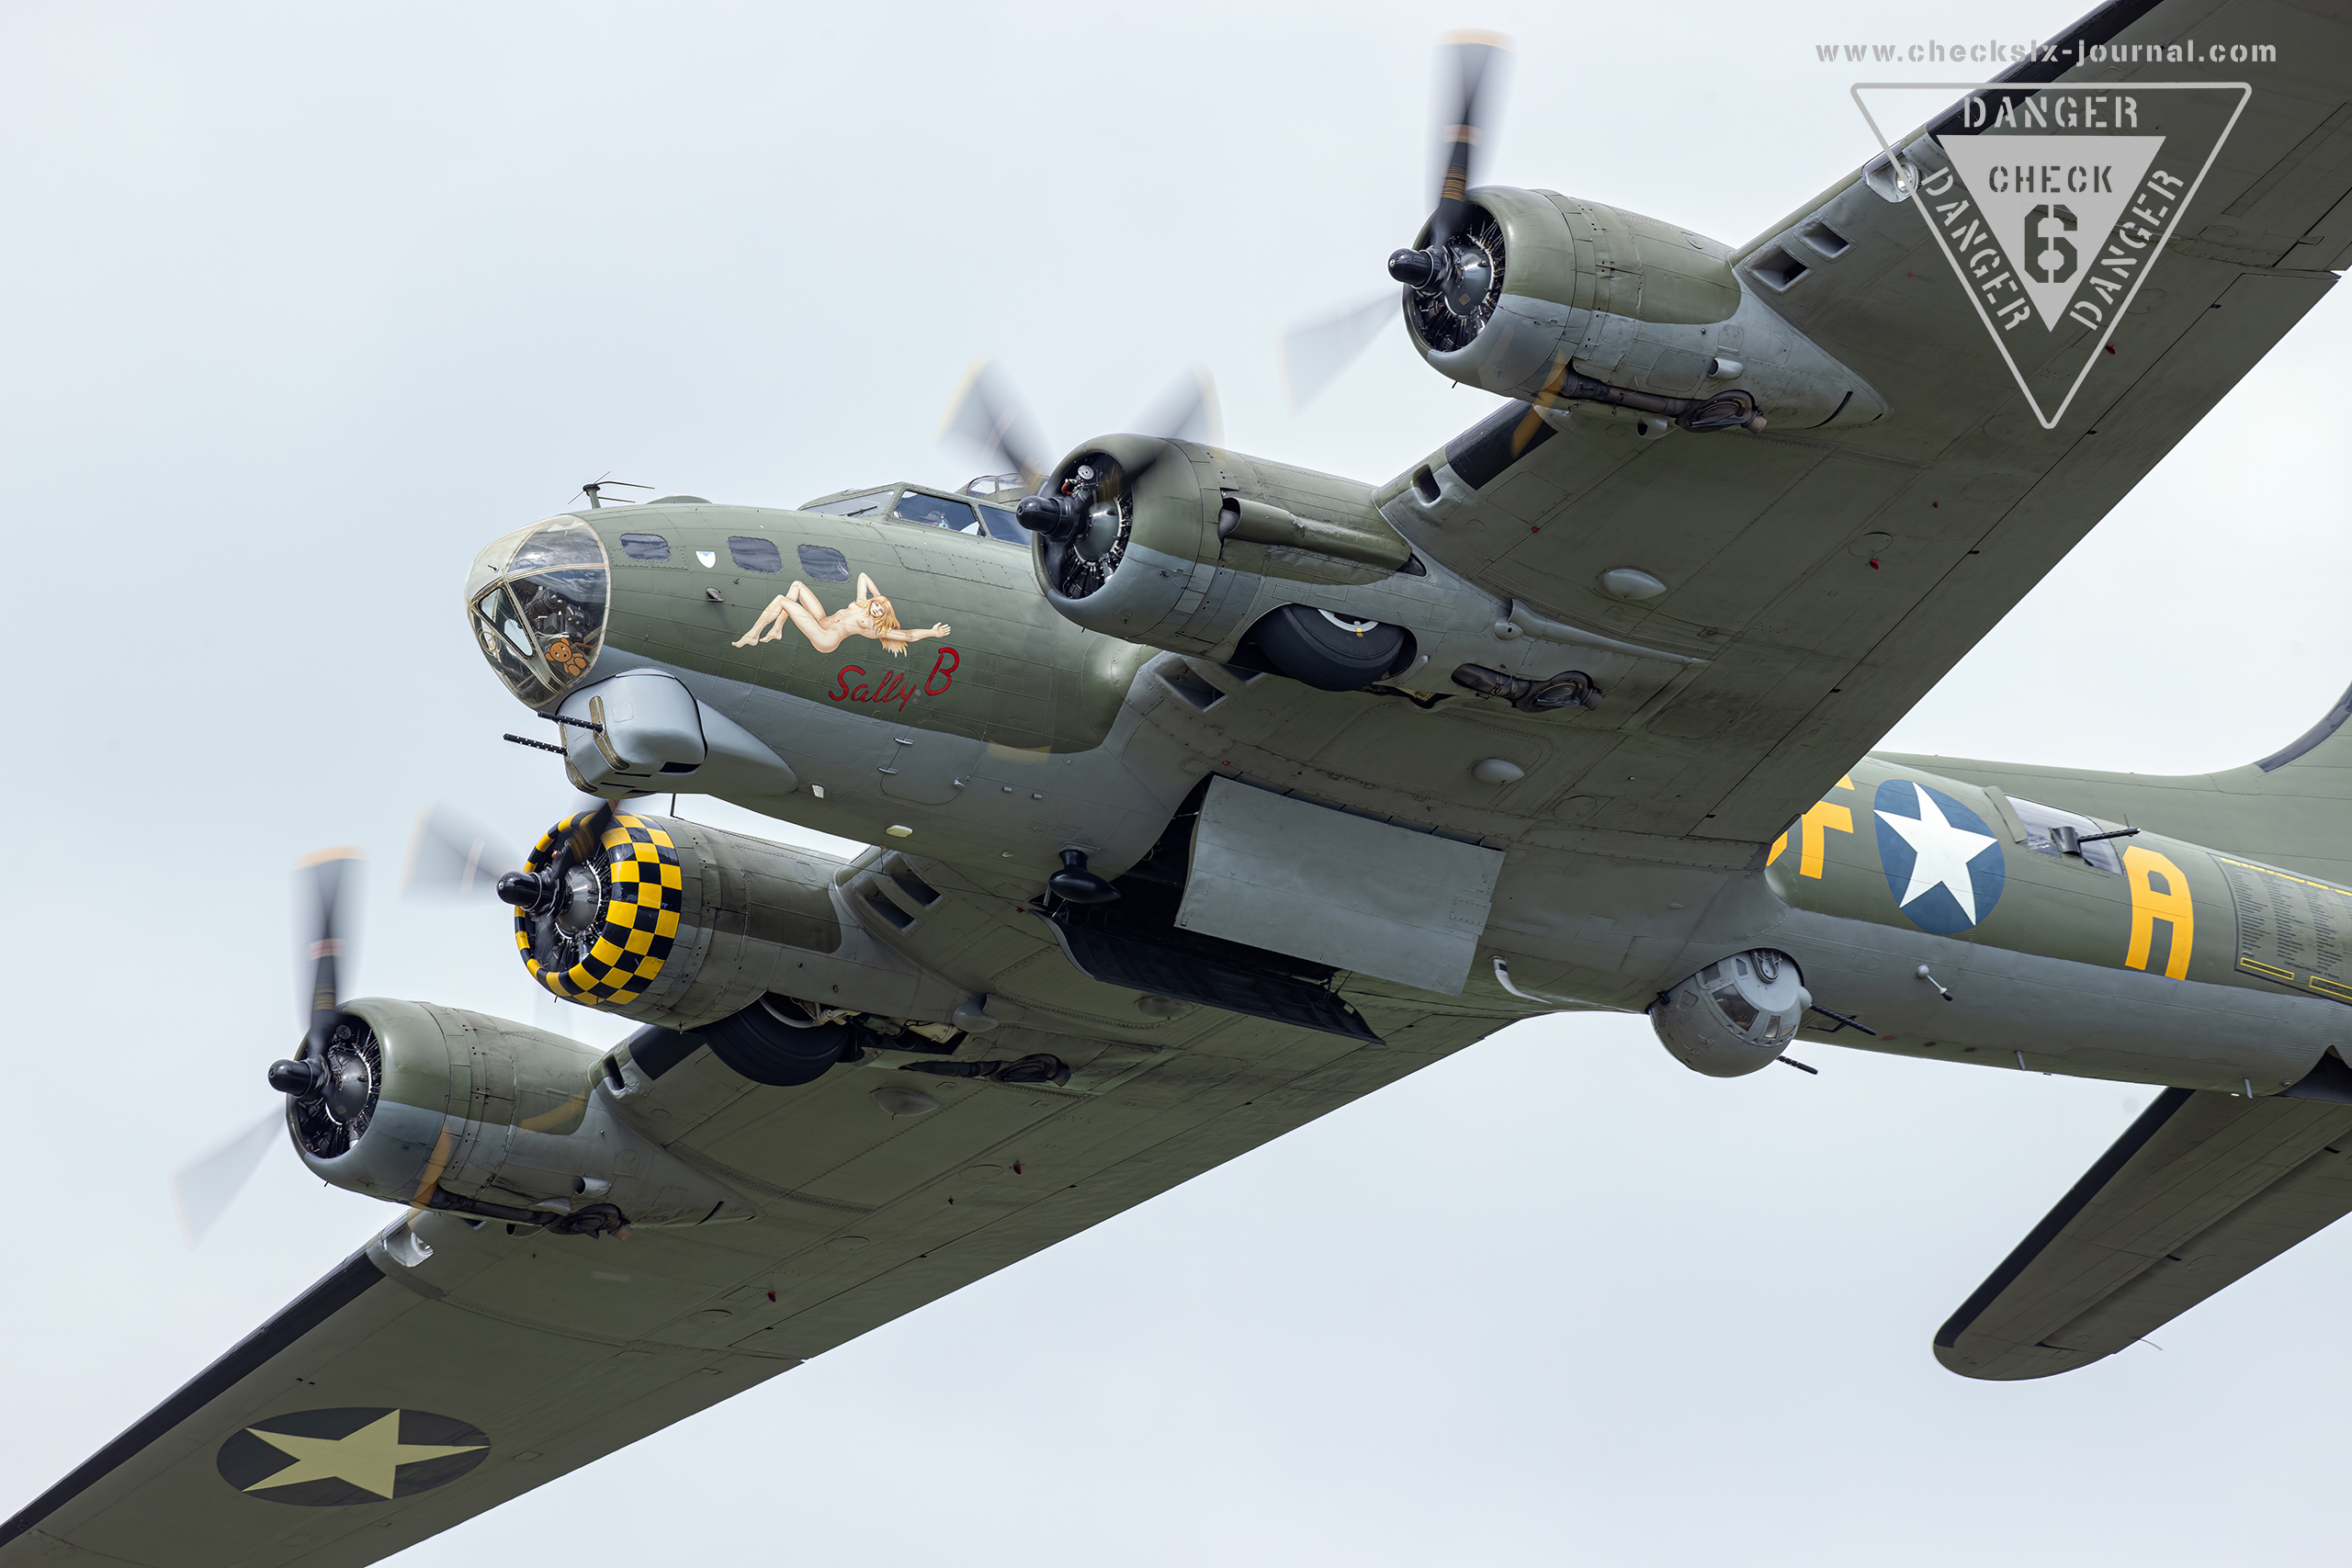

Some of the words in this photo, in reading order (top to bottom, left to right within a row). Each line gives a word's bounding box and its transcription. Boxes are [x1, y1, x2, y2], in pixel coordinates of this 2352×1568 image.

[829, 665, 917, 712] Sally
[924, 647, 960, 696] B
[1766, 773, 1855, 879] F
[2122, 845, 2194, 981] A
